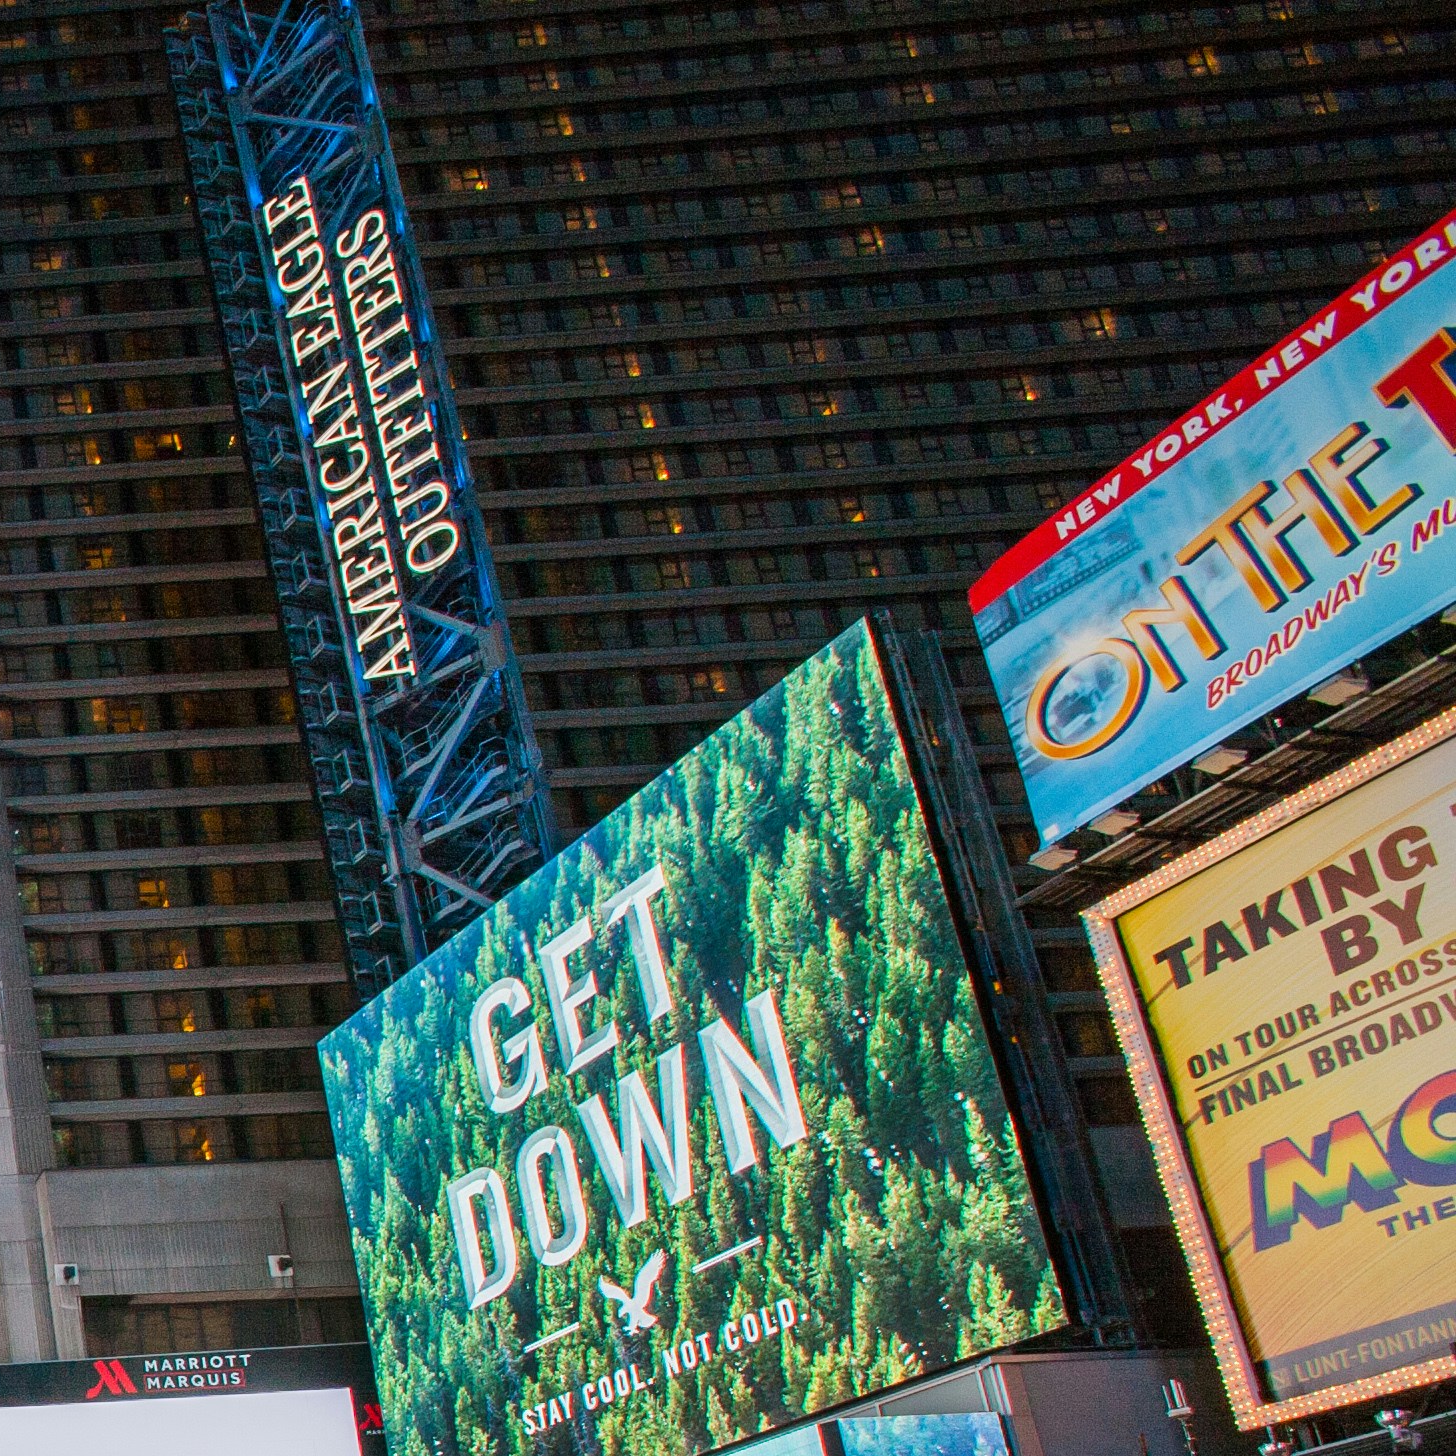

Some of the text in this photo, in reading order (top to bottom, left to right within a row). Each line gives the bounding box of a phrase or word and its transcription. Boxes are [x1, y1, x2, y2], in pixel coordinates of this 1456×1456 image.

[263, 175, 417, 682] AMERICAN EAGLE
[337, 208, 460, 577] OUTFITTERS
[1054, 314, 1338, 540] NEW YORK, NEW
[1025, 420, 1424, 761] ON THE
[1206, 538, 1397, 711] BROADWAY'S
[468, 864, 674, 1116] GET
[1154, 825, 1438, 991] TAKING
[1320, 882, 1426, 977] BY
[1188, 1002, 1320, 1080] ON TOUR
[1198, 1062, 1303, 1126] FINAL
[447, 990, 807, 1311] DOWN
[144, 1354, 251, 1373] MARRIOTT
[146, 1372, 242, 1390] MARQUIS
[522, 1297, 810, 1436] STAY COOL. NOT COLD.
